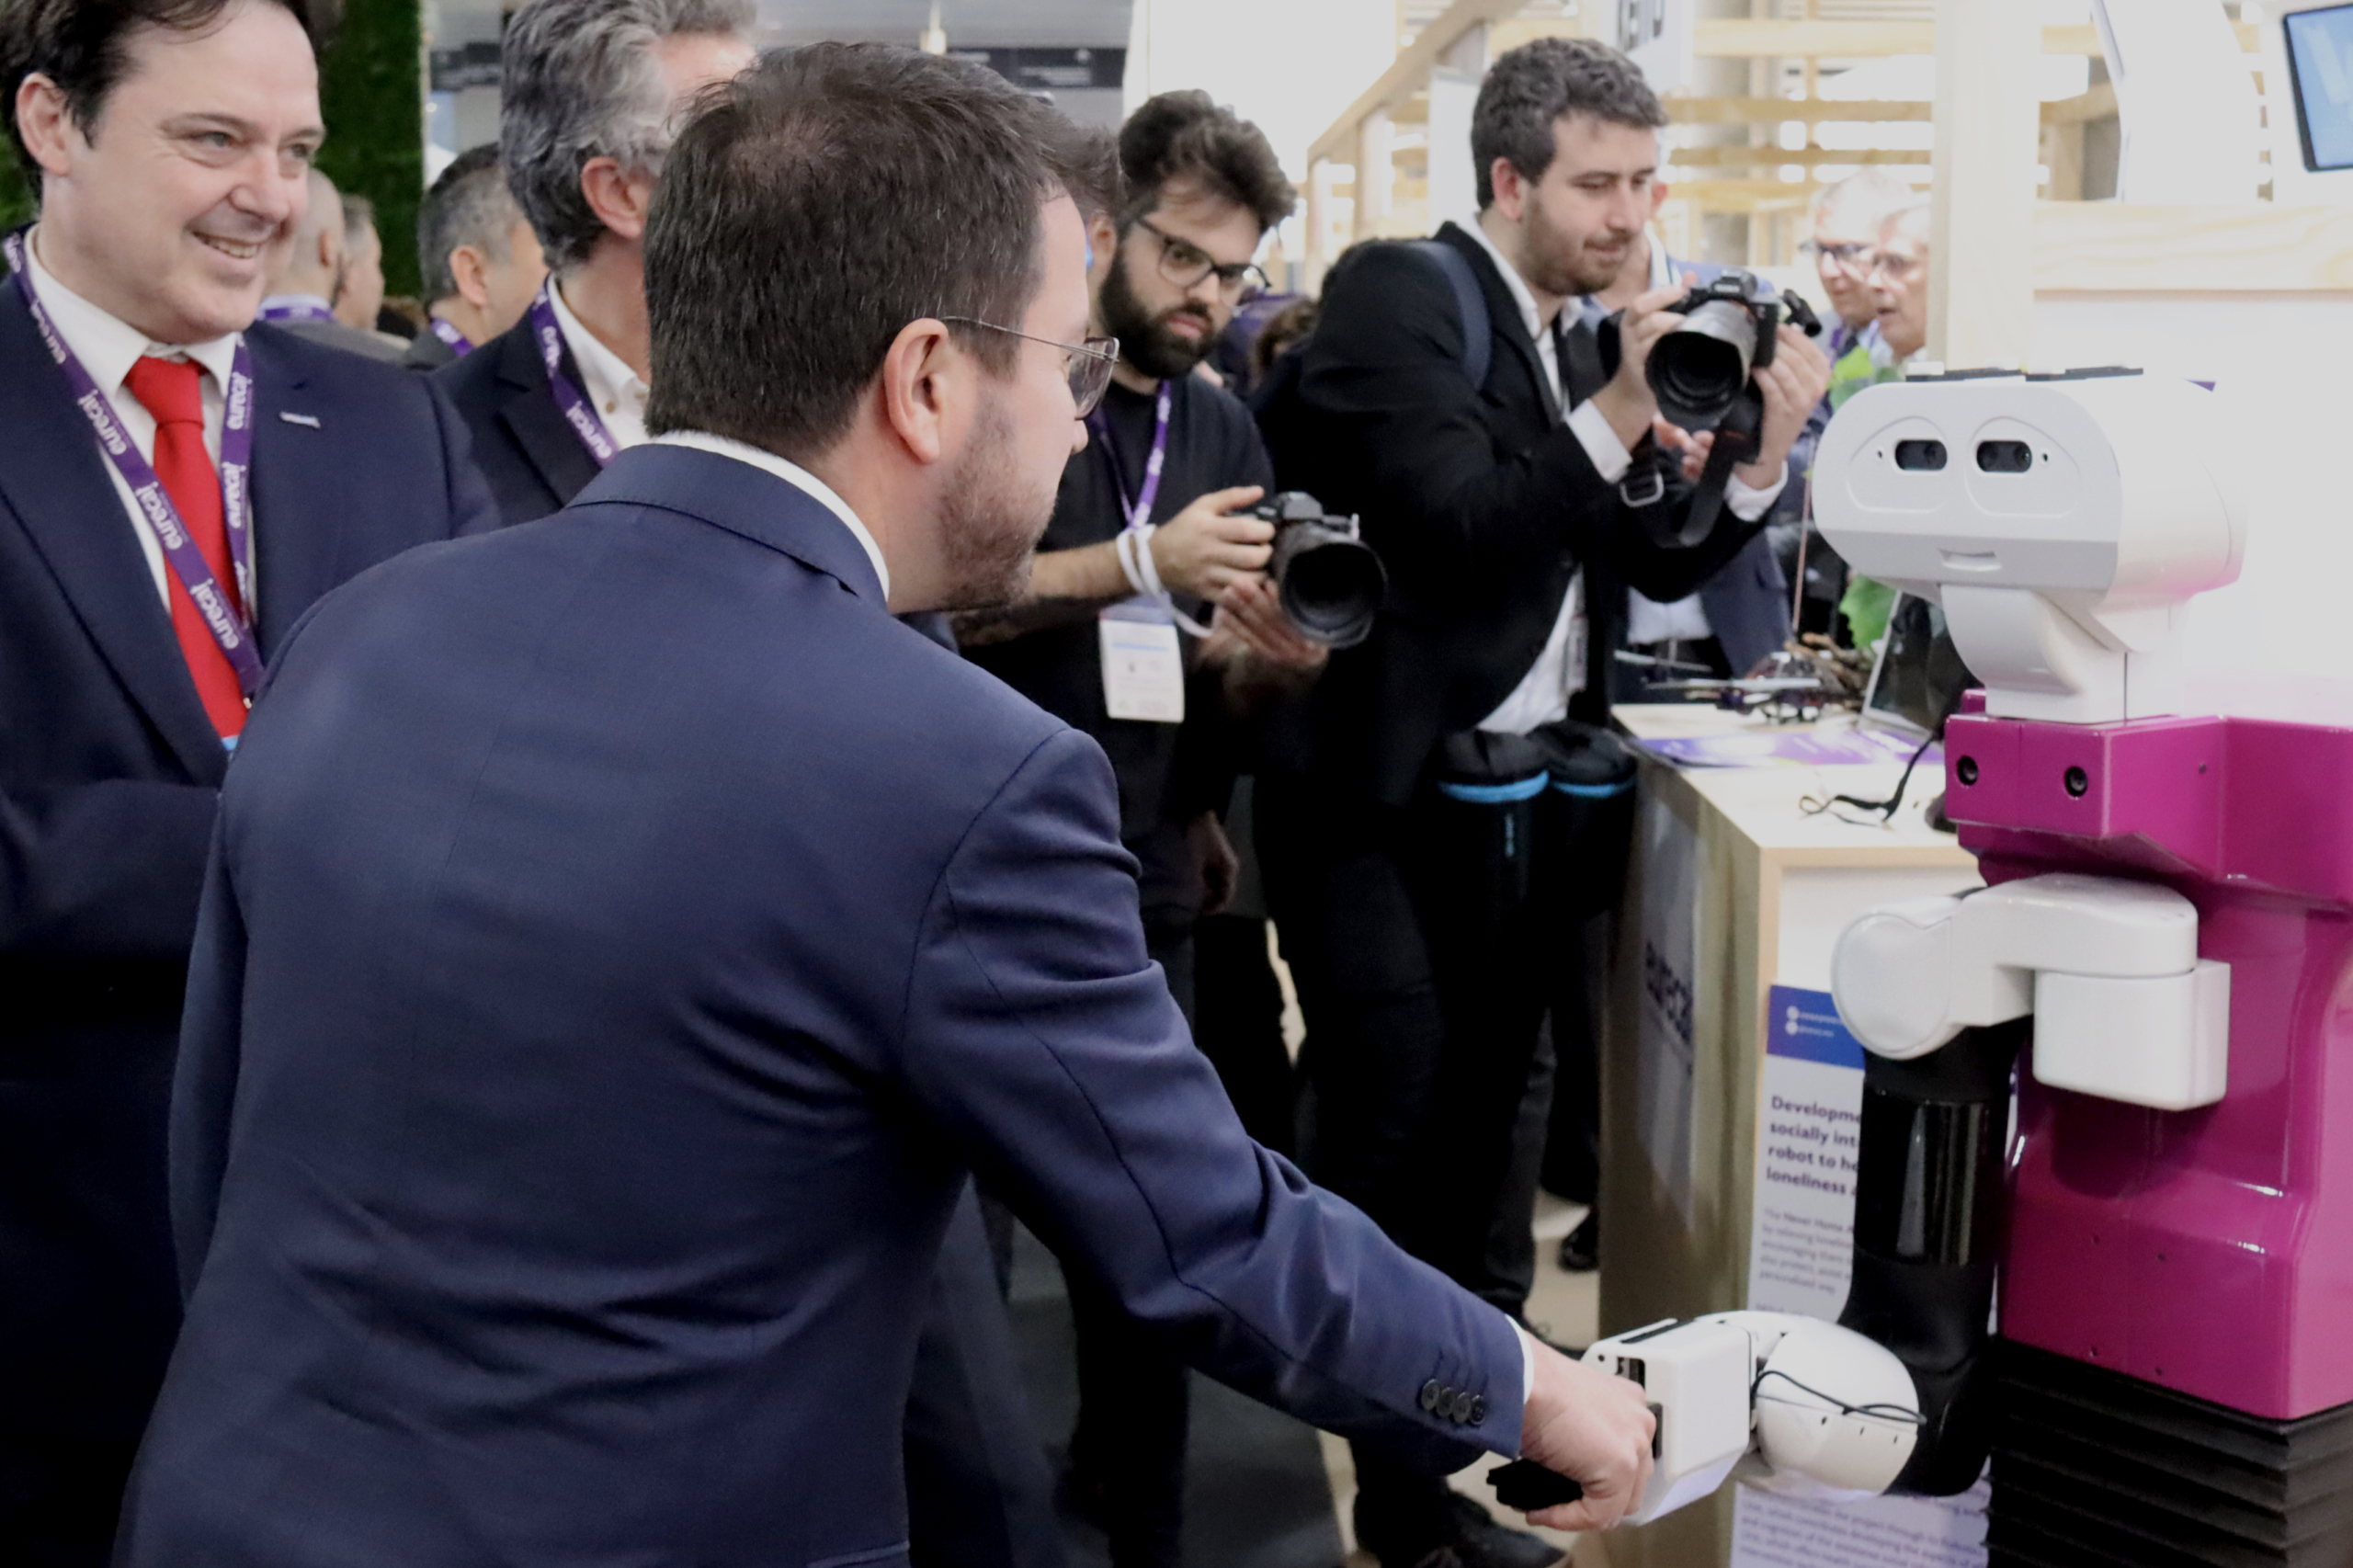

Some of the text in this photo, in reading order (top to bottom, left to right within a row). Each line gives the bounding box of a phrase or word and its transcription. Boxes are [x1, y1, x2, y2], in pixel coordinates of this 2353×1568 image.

[1770, 1122, 1828, 1145] socially
[1768, 1145, 1813, 1165] robot
[1819, 1154, 1836, 1168] to
[1767, 1165, 1847, 1195] loneliness
